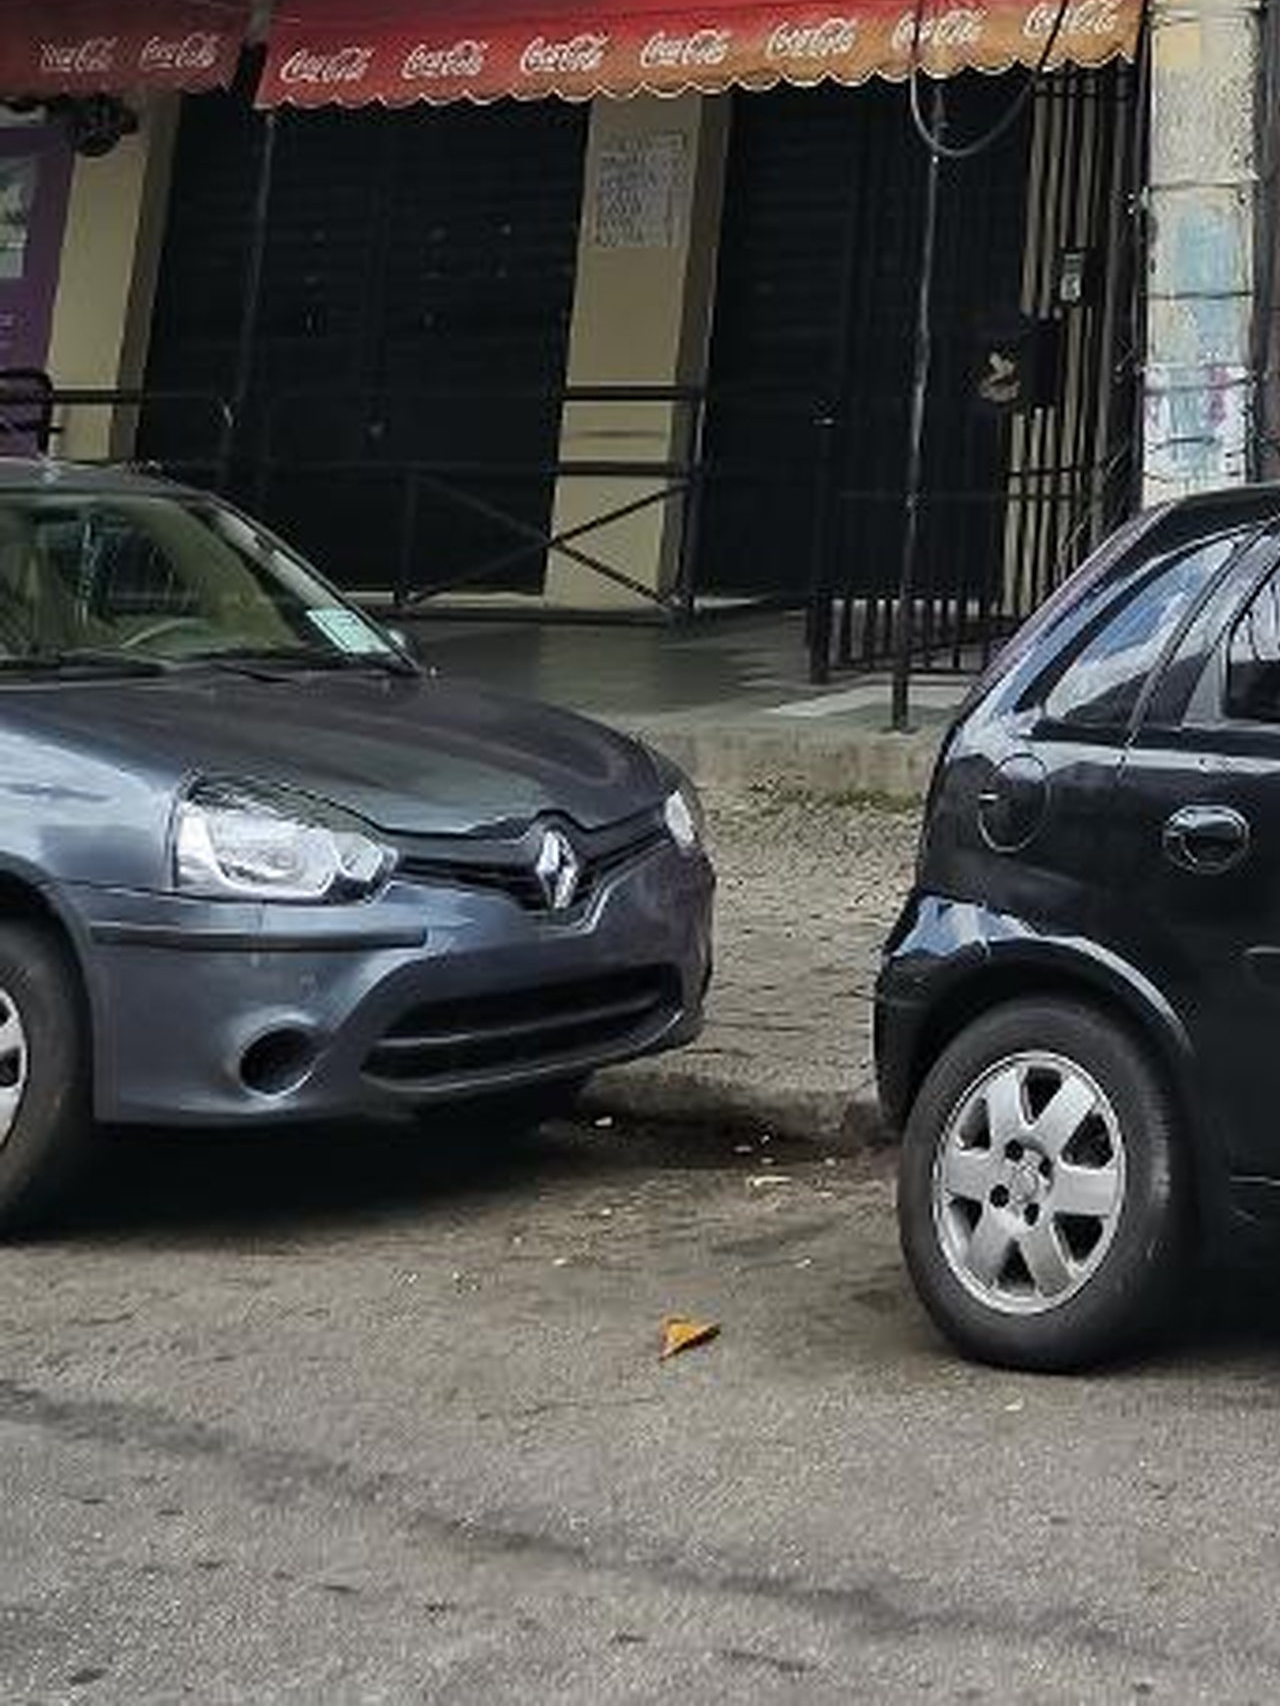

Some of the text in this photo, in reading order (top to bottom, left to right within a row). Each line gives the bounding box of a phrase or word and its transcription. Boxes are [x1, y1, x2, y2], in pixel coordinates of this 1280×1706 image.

[279, 46, 375, 84] Coca-Cola
[402, 39, 488, 80] Coca-Cola
[519, 32, 611, 73] Coca-Cola
[640, 28, 735, 68] Coca-Cola
[765, 17, 858, 59] Coca-Cola
